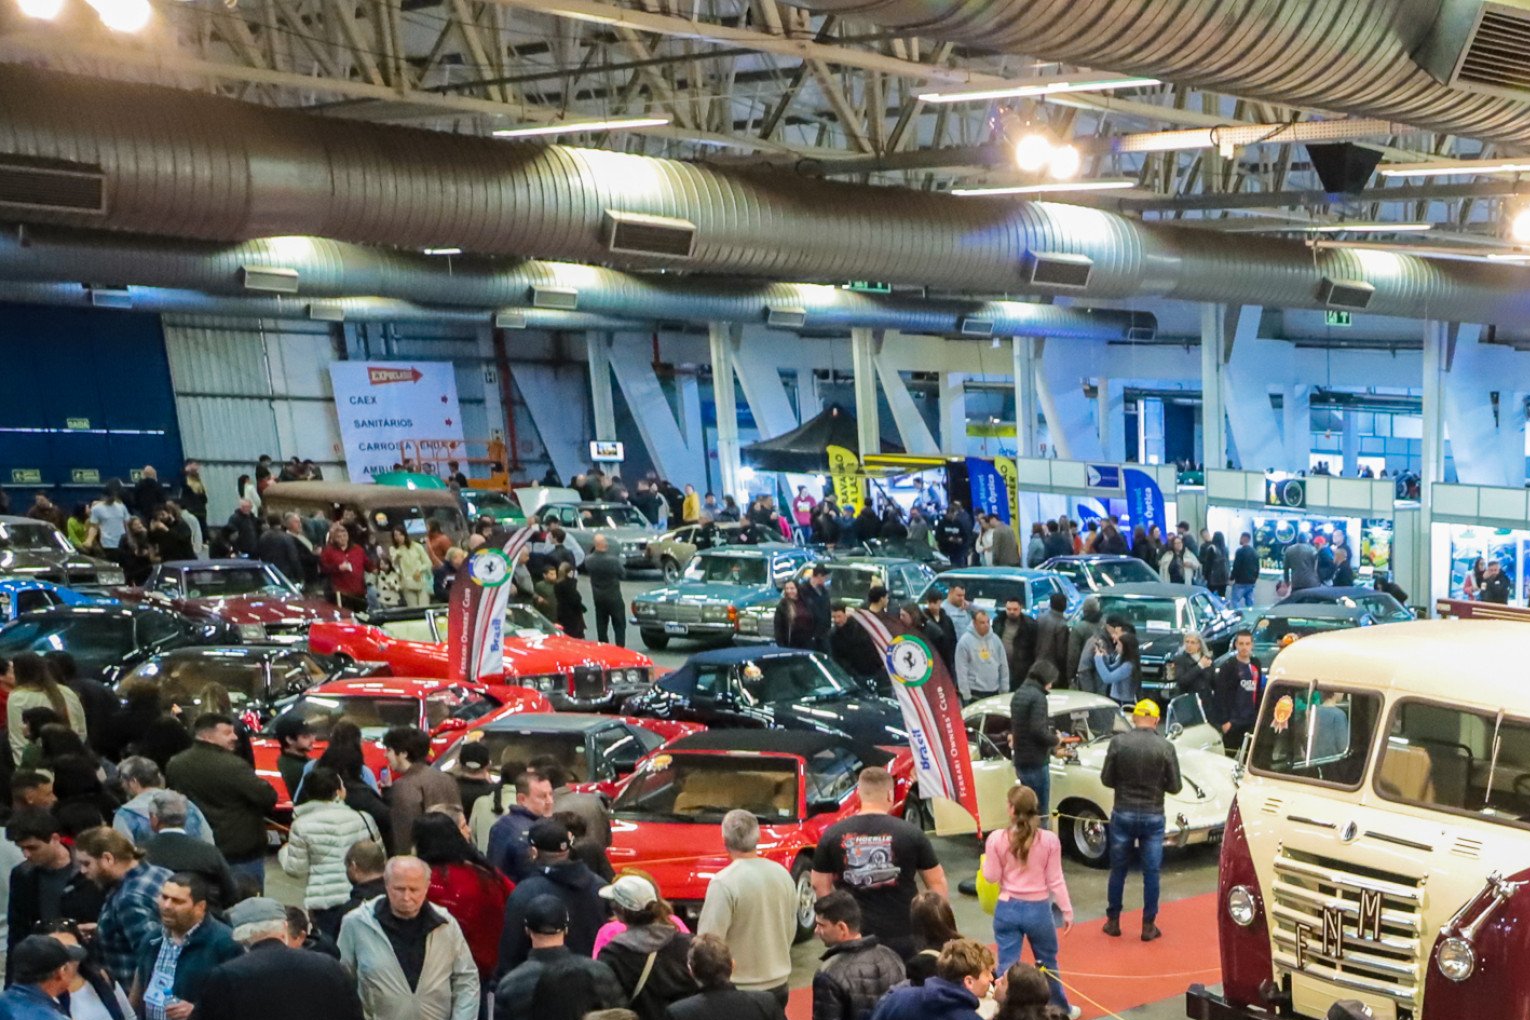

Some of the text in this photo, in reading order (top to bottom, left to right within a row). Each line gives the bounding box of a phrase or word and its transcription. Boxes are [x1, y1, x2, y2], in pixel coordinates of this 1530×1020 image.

[349, 396, 377, 405] CAEX
[353, 418, 413, 429] SANITÁRIOS
[490, 618, 501, 653] Brasil
[911, 727, 931, 771] Brasil
[1295, 888, 1382, 971] FNM
